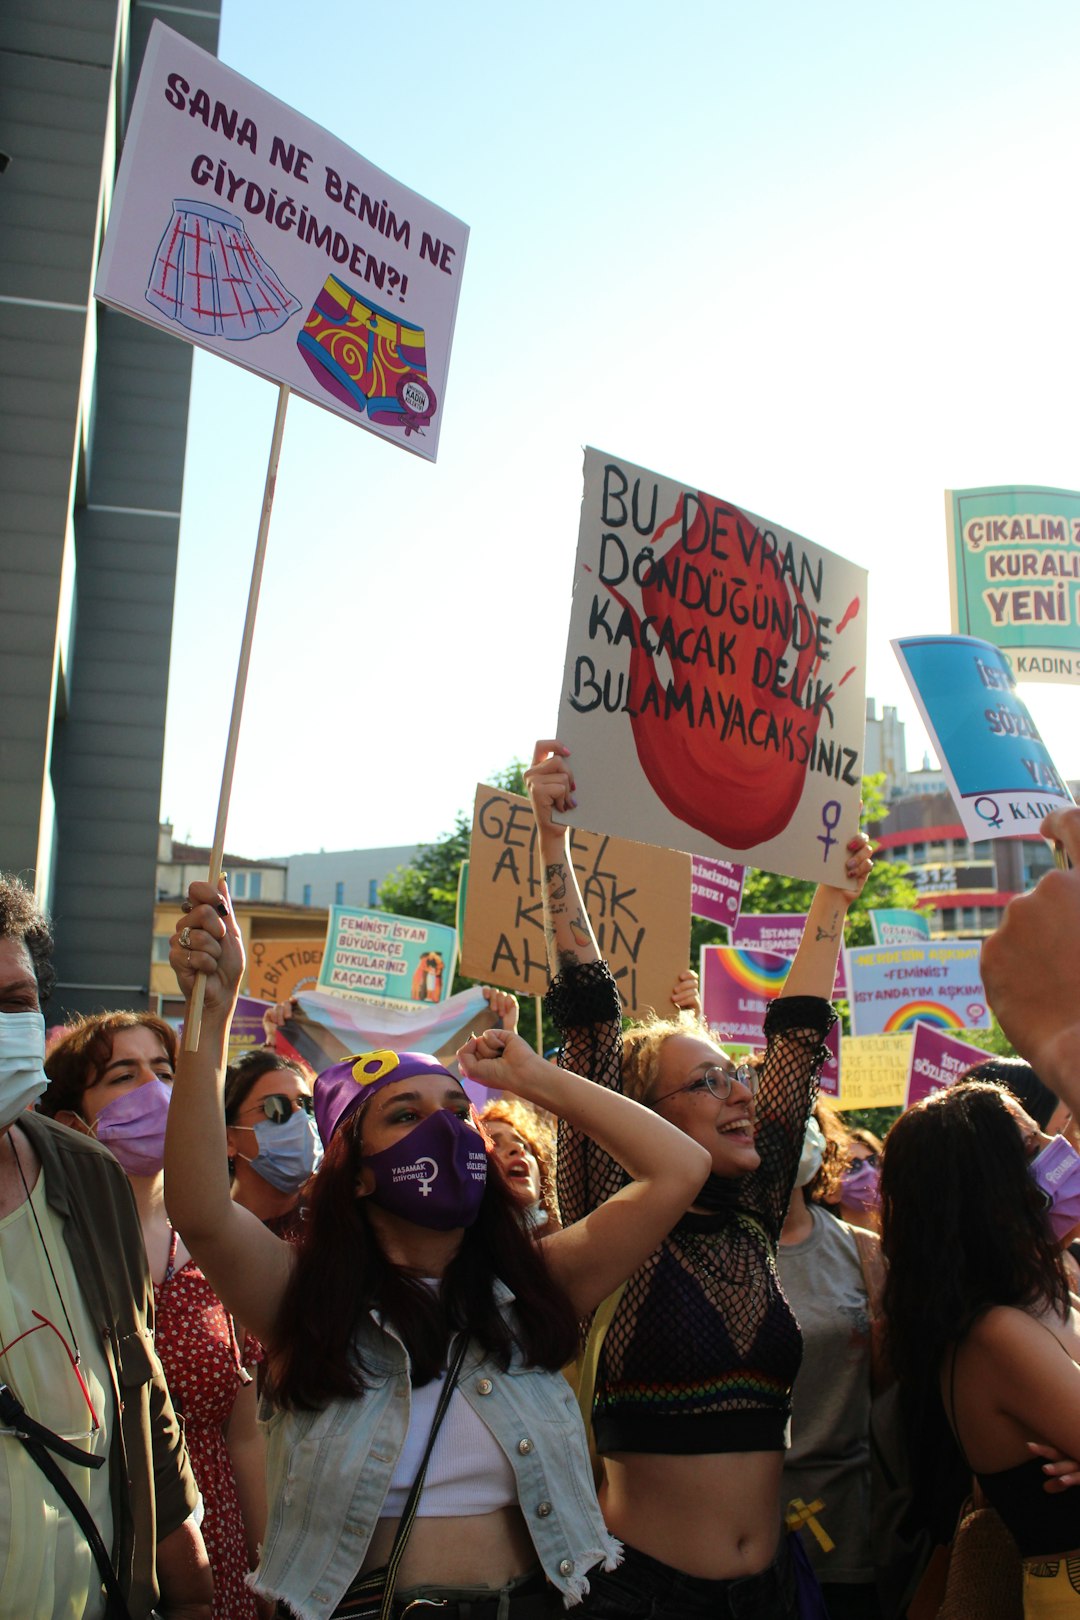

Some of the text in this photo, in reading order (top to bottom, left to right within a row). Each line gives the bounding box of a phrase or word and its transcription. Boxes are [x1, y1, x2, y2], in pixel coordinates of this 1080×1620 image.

[164, 72, 455, 275] SANA NE BENİM NE
[190, 153, 409, 303] GİYDİĞİMDEN?!
[600, 464, 823, 602] BU DEVRAN
[968, 518, 1066, 550] ÇIKALIM
[989, 553, 1080, 578] KURALI
[599, 533, 834, 662] DÖNDÜĞÜNDE
[986, 582, 1067, 622] YENİ
[588, 594, 834, 729] KAÇACAK DELİK
[1017, 656, 1073, 675] KADIN
[566, 655, 859, 787] BULAMAYACAKSINIZ
[1008, 801, 1058, 820] KAD
[478, 796, 617, 882] GEEL
[338, 934, 402, 956] BÜYÜDÜKÇE
[341, 917, 426, 941] FEMİNİST İSYAN
[332, 970, 385, 988] KAÇACAK
[336, 953, 406, 974] UYKULARINIZ
[391, 1162, 426, 1175] YAŞAMAK
